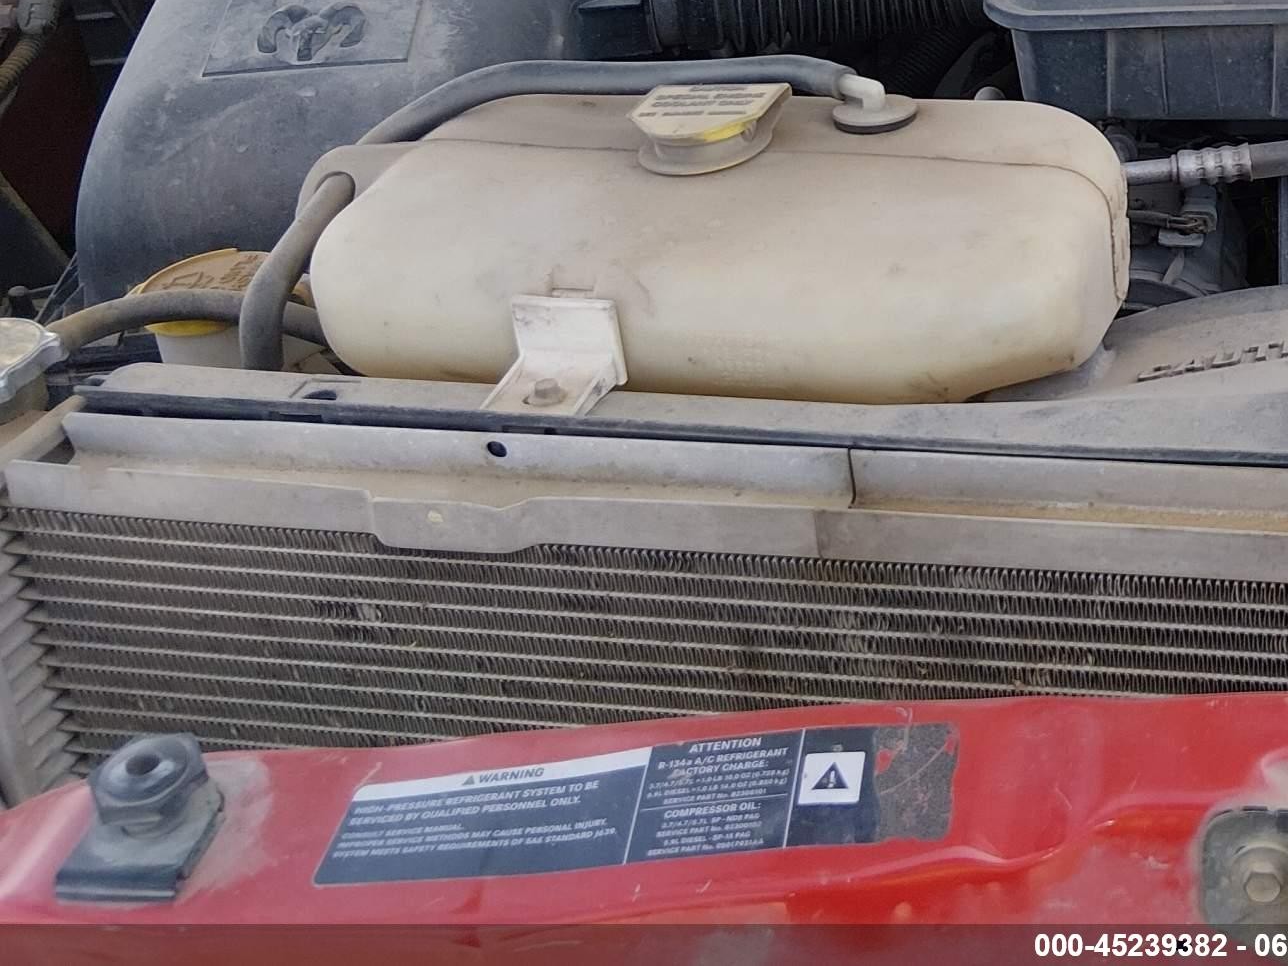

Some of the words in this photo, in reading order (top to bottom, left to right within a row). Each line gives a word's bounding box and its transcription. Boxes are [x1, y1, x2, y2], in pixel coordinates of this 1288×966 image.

[689, 737, 762, 753] ATTENTION
[657, 759, 693, 770] R-134a
[693, 755, 715, 766] A/C
[715, 747, 789, 763] REFRIGERANT
[721, 759, 769, 772] CHARGE:
[479, 767, 545, 783] WARNING
[444, 790, 521, 805] REFRIGERANT
[522, 785, 567, 798] SYSTEM
[569, 782, 582, 793] TO
[584, 780, 600, 791] BE
[696, 792, 716, 801] PART
[349, 814, 406, 826] SERVICED
[405, 812, 420, 821] BY
[421, 806, 480, 819] QUALIFIED
[481, 799, 547, 813] PERSONNEL
[549, 795, 581, 807] ONLY.
[664, 803, 737, 819] COMPRESSOR
[739, 802, 762, 811] OIL:
[524, 823, 573, 835] PERSONAL
[689, 825, 709, 834] PART
[680, 835, 707, 844] DIESEL
